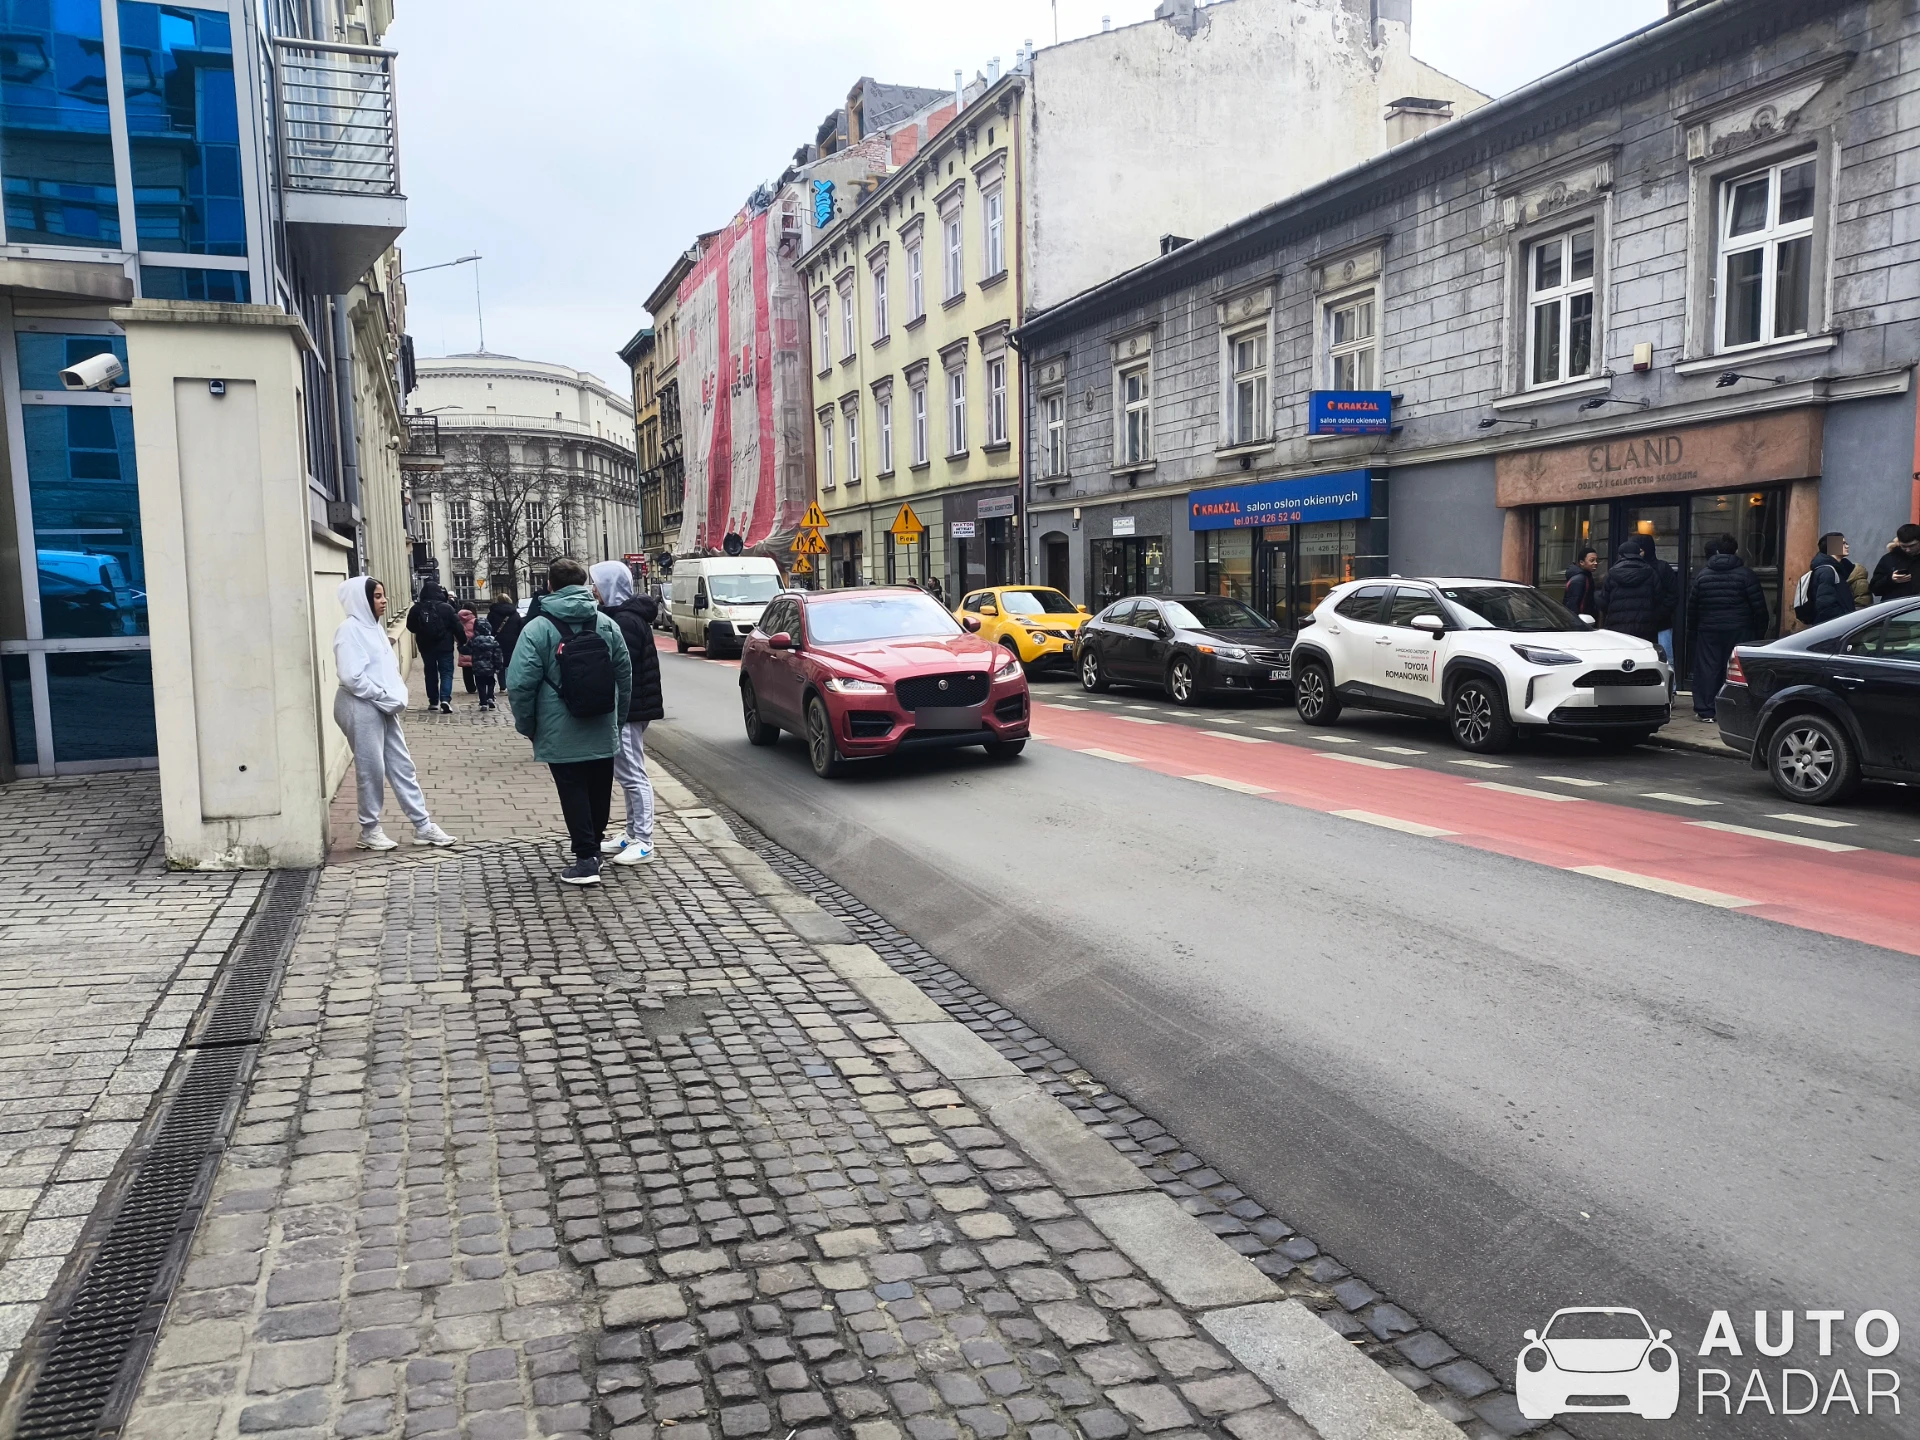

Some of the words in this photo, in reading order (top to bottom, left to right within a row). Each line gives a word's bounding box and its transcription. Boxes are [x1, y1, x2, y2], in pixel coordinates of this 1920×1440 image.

[1337, 400, 1379, 410] KRAKŻAL
[1356, 417, 1387, 425] okiennych
[1588, 435, 1683, 472] ELAND
[1610, 475, 1654, 487] GALANTERIA
[1657, 470, 1698, 482] SKÓRZANA
[1201, 500, 1241, 515] KRAKŻAL
[1246, 500, 1271, 512] salon
[1274, 498, 1301, 509] osłon
[1303, 490, 1358, 507] okiennych
[1233, 515, 1259, 526] tel.012
[1261, 513, 1276, 524] 426
[1278, 512, 1288, 522] 52
[1290, 511, 1301, 521] 40
[1404, 661, 1429, 671] TOYOTA
[1385, 670, 1429, 682] ROMANOWSKI
